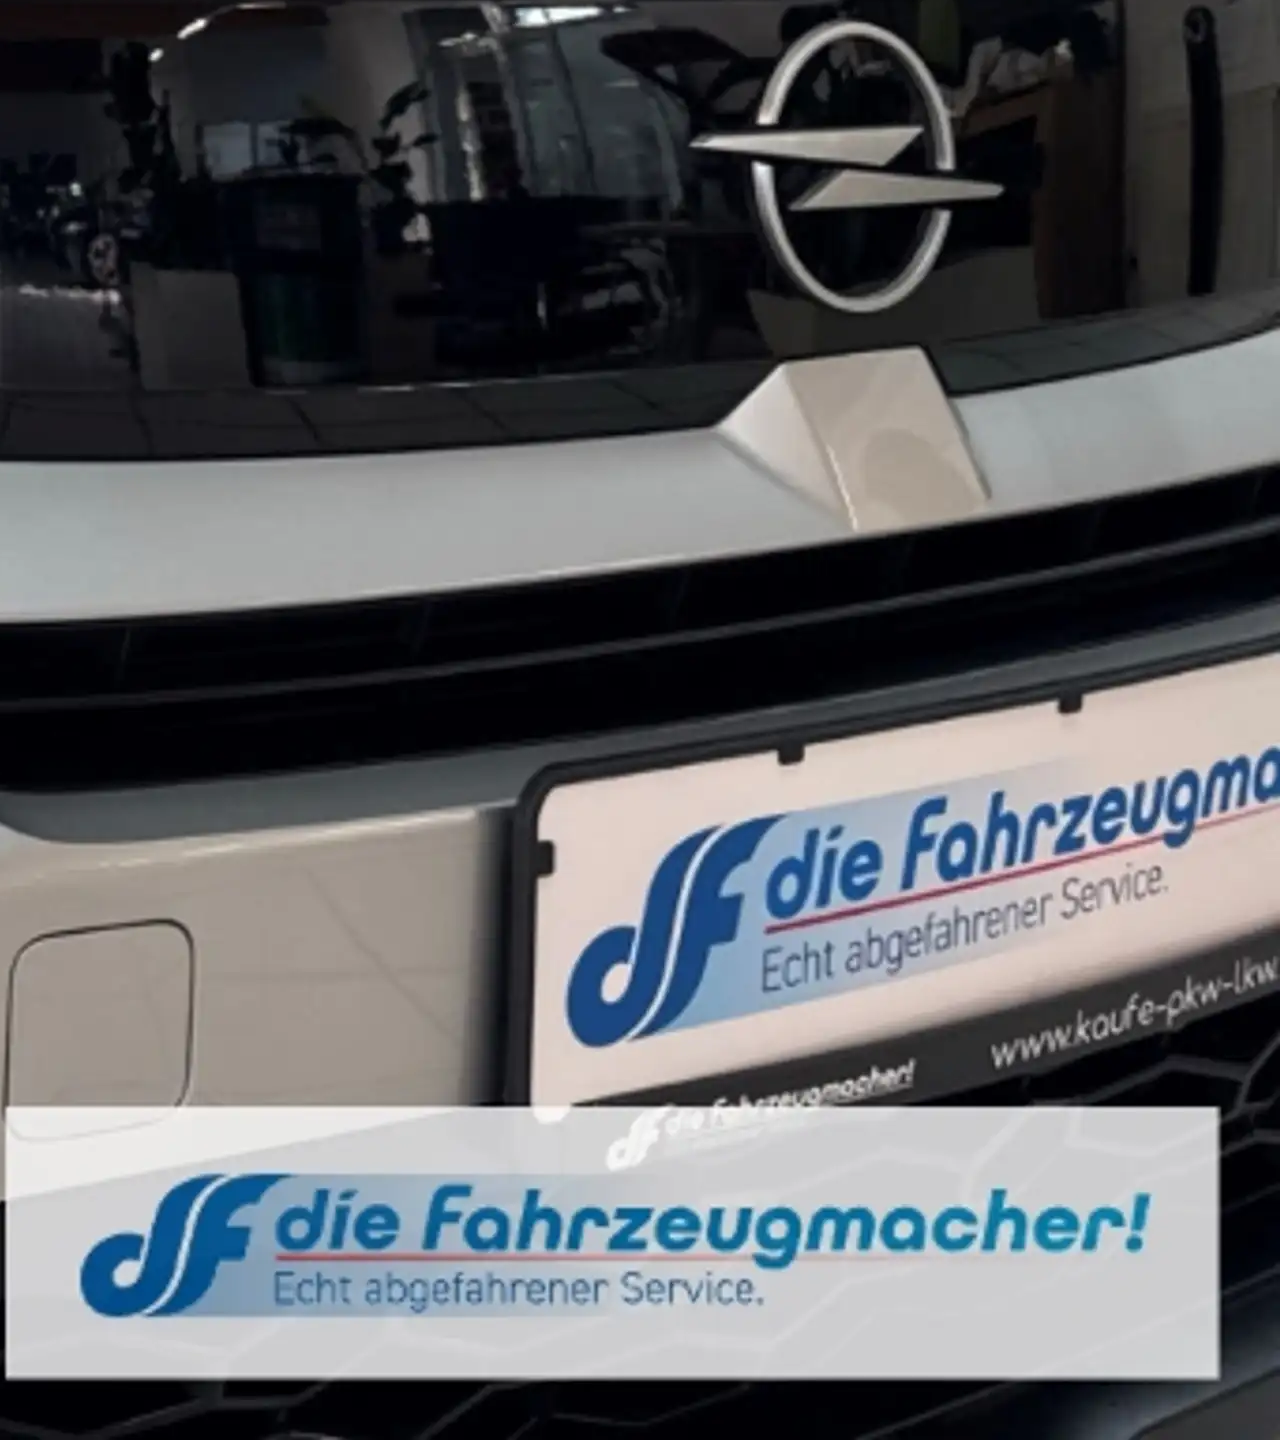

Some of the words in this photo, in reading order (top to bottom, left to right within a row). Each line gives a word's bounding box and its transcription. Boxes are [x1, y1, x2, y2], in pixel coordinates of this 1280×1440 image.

[760, 941, 836, 994] Echt
[844, 891, 1054, 977] abgefahrener
[1060, 861, 1170, 921] Service.
[764, 824, 884, 920] die
